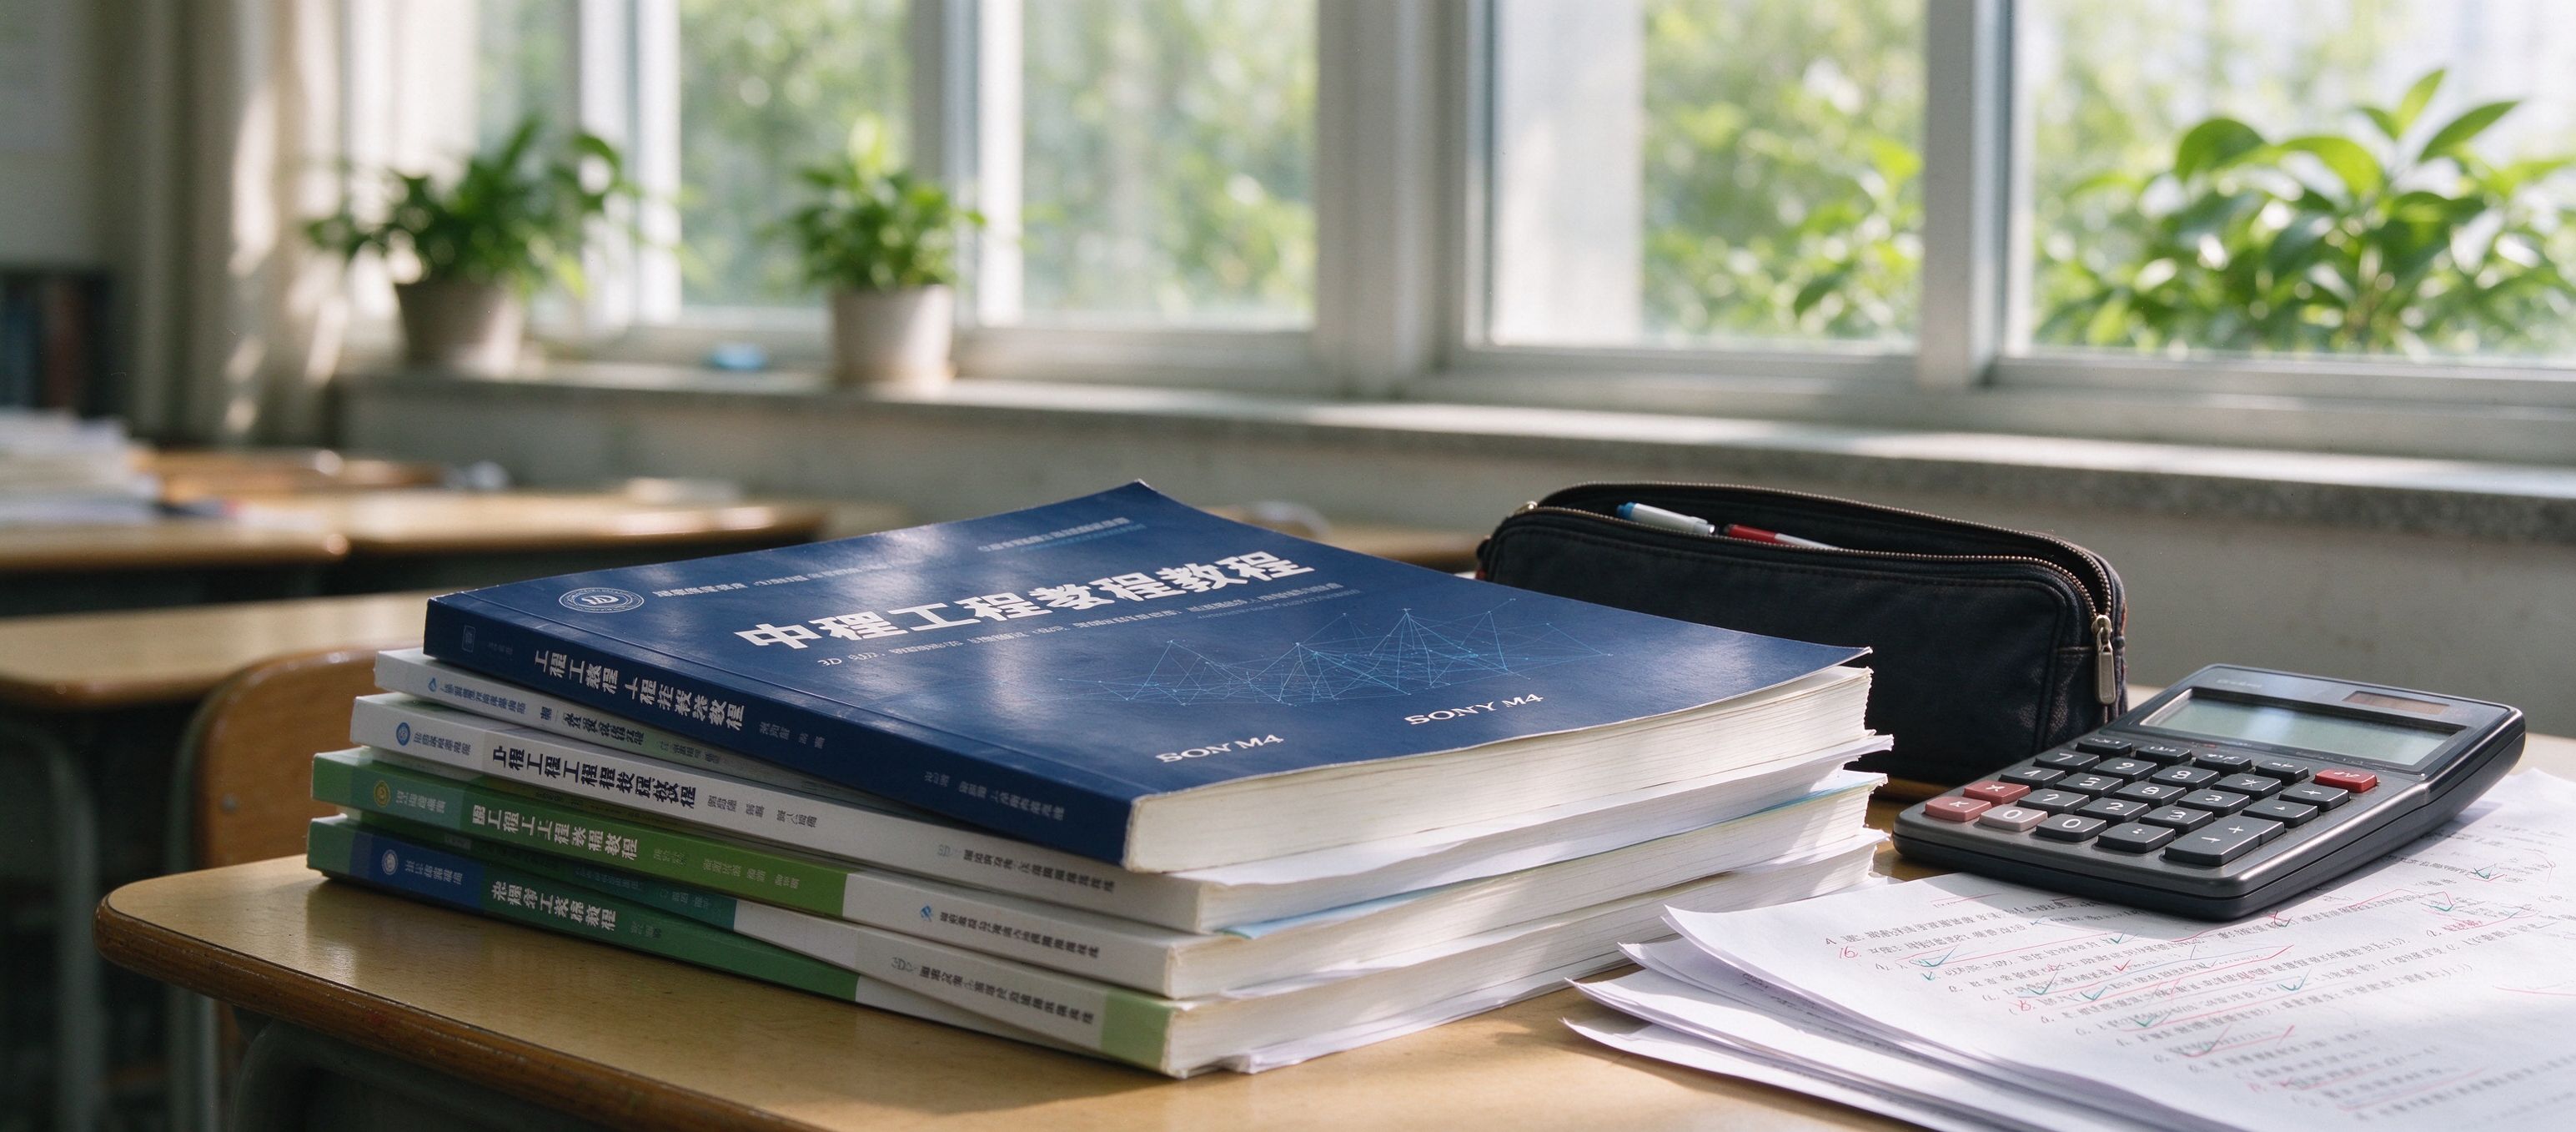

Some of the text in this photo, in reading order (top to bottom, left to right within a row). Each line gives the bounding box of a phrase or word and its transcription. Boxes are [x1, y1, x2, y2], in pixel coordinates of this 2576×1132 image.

[1404, 701, 1496, 725] SONY
[2003, 809, 2081, 828] 0 0
